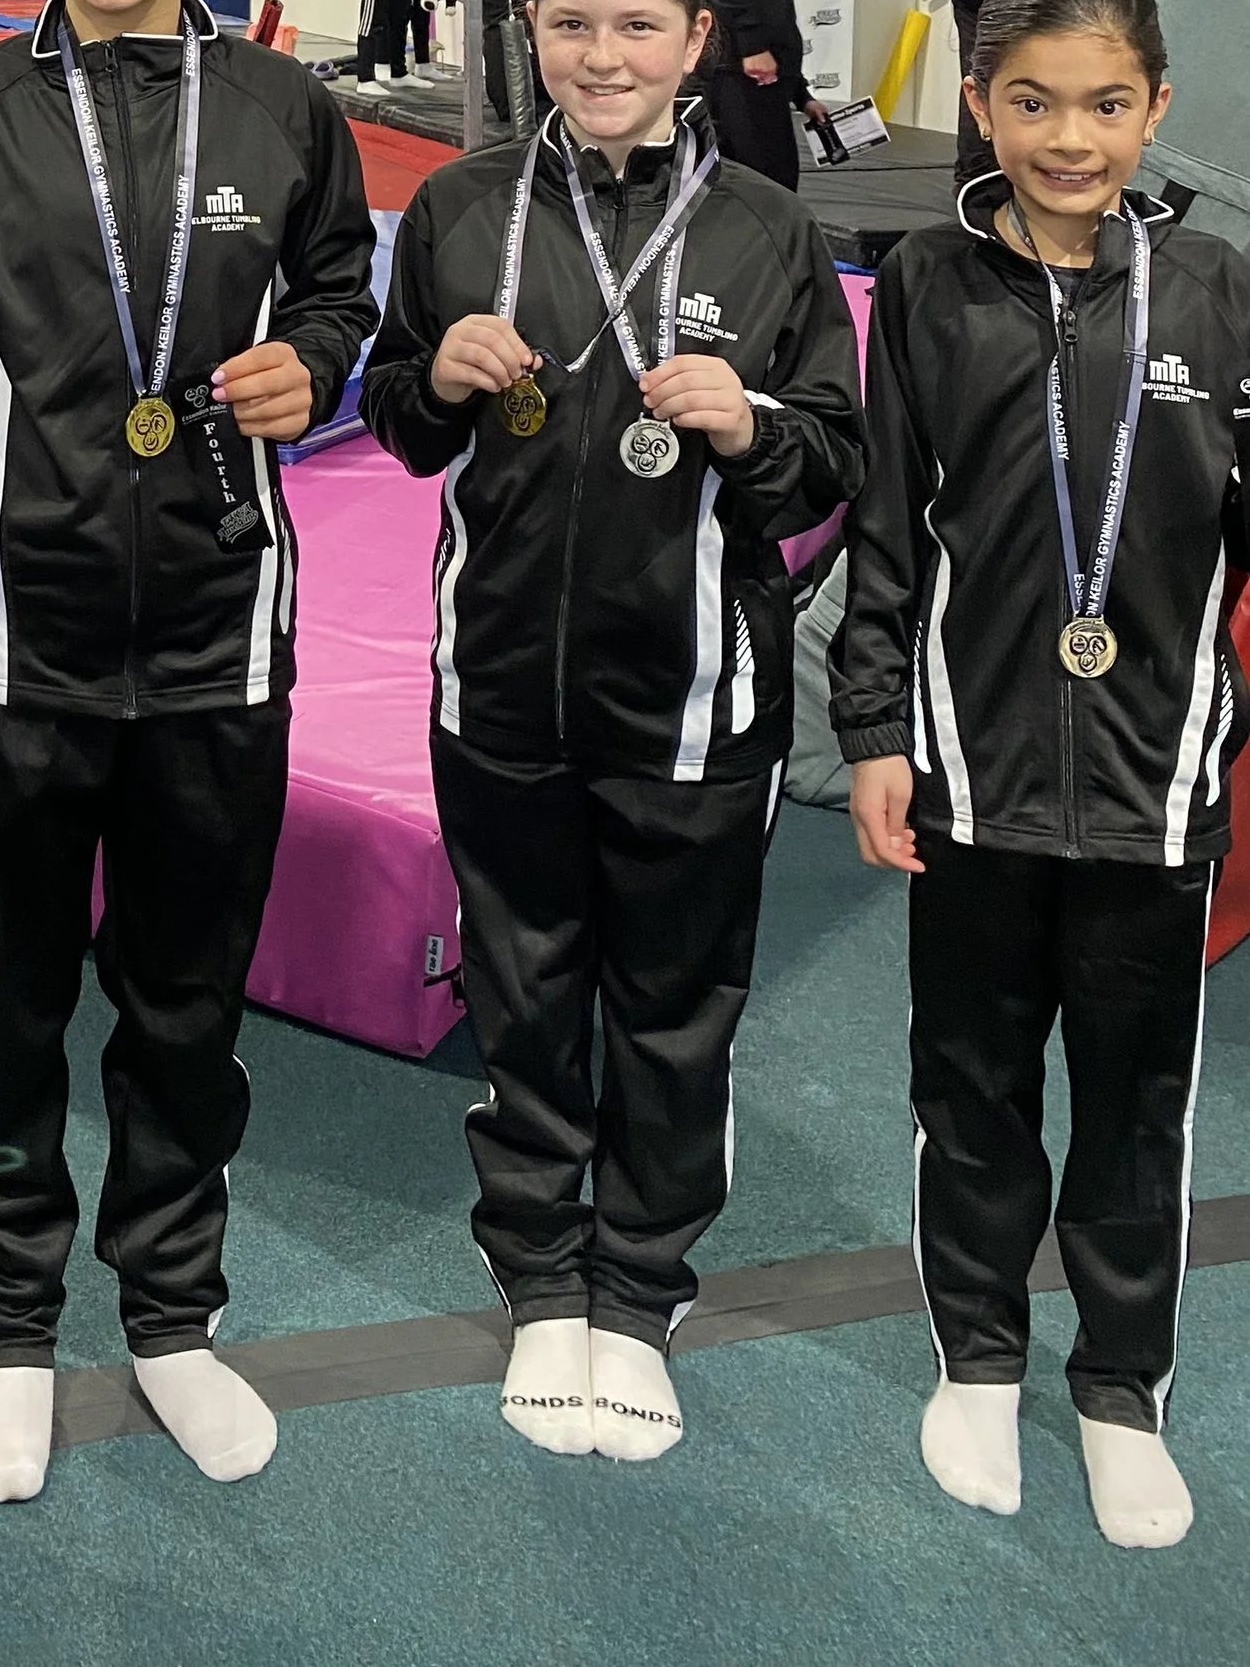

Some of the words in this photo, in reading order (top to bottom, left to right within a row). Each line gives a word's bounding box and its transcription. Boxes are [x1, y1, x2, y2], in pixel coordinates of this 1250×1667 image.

[186, 25, 196, 77] ESSENDON
[72, 67, 93, 124] ESSENDON
[84, 121, 102, 164] KEILOR
[93, 165, 119, 237] GYMNASTICS
[110, 238, 131, 294] ACADEMY
[174, 175, 190, 231] ACADEMY
[510, 178, 527, 222] ACADEMY
[191, 215, 230, 225] ELBOURNE
[211, 223, 245, 232] ACADEMY
[165, 230, 185, 305] GYMNASTICS
[503, 222, 519, 289] GYMNASTICS
[590, 232, 615, 285] ESSENDON
[638, 224, 675, 274] ESSENDON
[1133, 241, 1145, 300] ESSENDON
[499, 288, 512, 319] EILOR
[659, 249, 677, 316] GYMNASTICS
[158, 306, 174, 351] KEILOR
[657, 319, 669, 357] KEILOR
[675, 317, 702, 330] OURNE
[703, 324, 738, 341] TUMBLING
[679, 326, 716, 342] ACADEMY
[151, 351, 167, 392] ENDON
[1051, 355, 1062, 400] ASTICS
[1142, 382, 1176, 393] BOURNE
[1152, 392, 1191, 404] ACADEMY
[1052, 402, 1070, 461] ACADEMY
[1111, 420, 1131, 480] ACADEMY
[203, 422, 236, 504] Fourth
[1097, 479, 1122, 554] GYMNASTICS
[1090, 556, 1107, 602] KEILOR
[595, 1397, 681, 1428] BONDS
